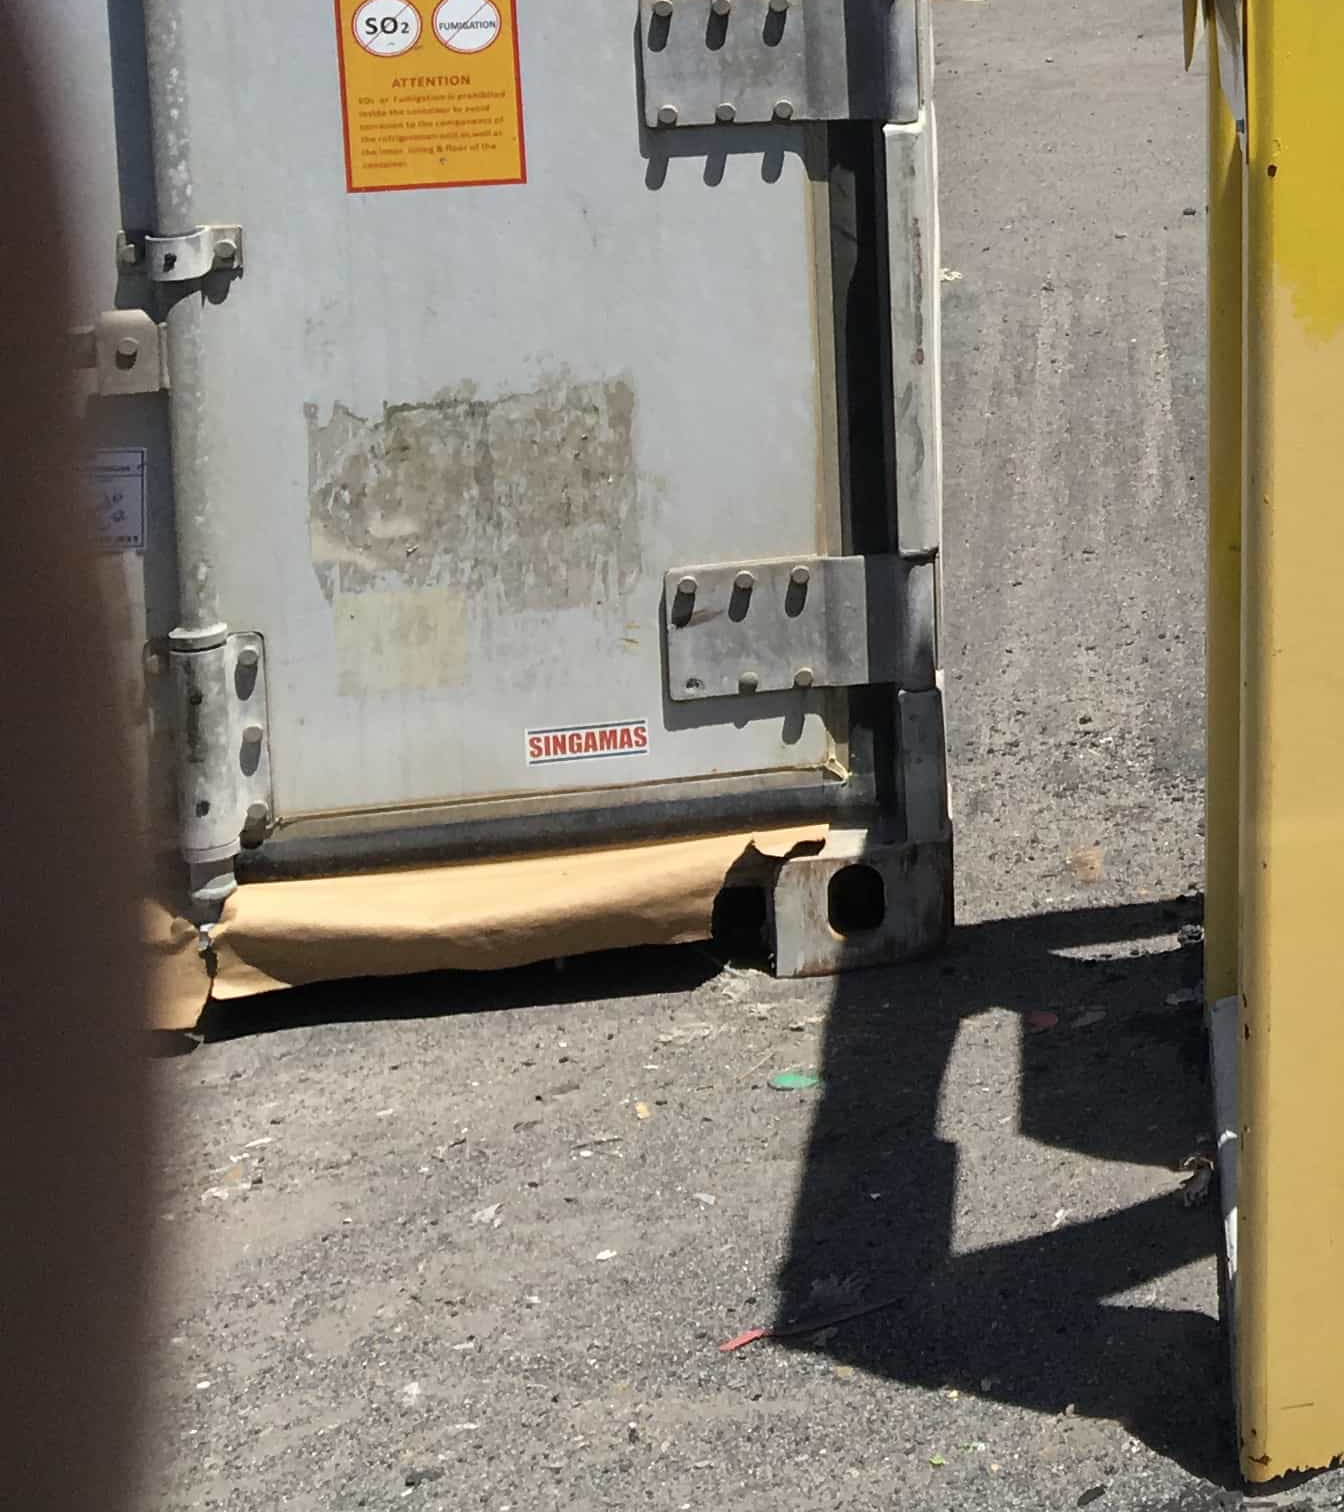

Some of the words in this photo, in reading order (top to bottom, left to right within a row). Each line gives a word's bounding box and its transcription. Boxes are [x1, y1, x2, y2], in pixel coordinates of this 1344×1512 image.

[438, 19, 498, 32] FUMIGATION
[391, 74, 471, 89] ATTENTION
[528, 724, 648, 759] SINGAMAS
